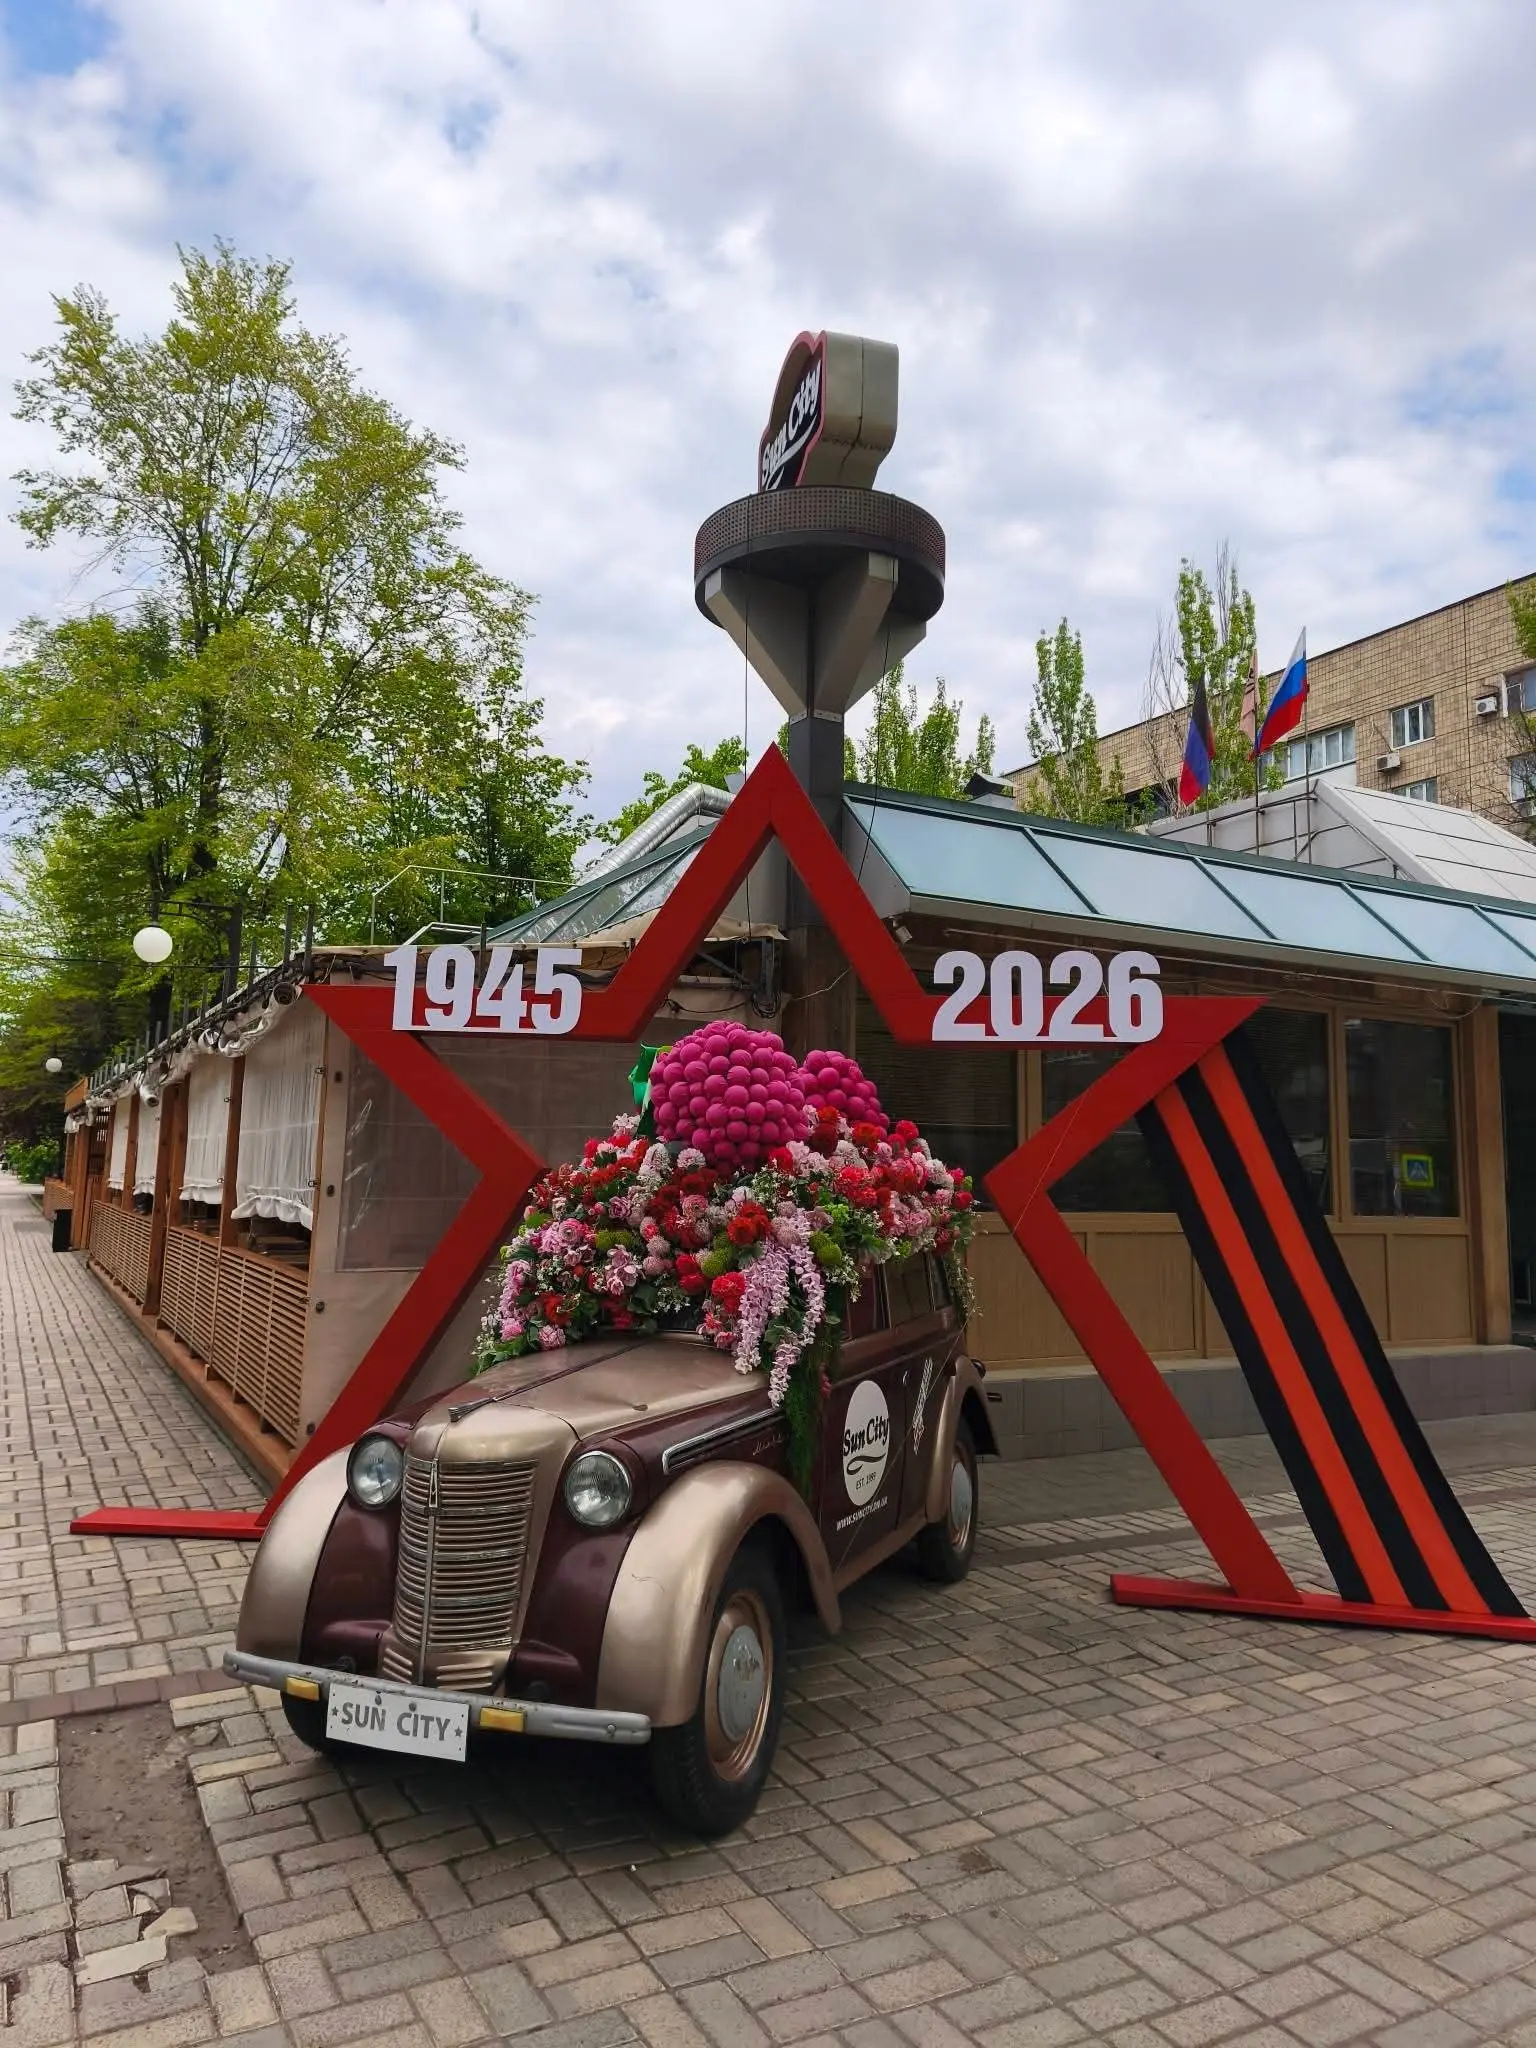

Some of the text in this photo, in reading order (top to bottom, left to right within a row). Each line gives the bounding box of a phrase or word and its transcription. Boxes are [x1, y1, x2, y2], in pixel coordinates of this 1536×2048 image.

[788, 359, 821, 441] City
[383, 944, 583, 1034] 1945
[931, 950, 1163, 1042] 2026
[843, 1415, 889, 1456] Sun City
[341, 1702, 451, 1741] SUN CITY
